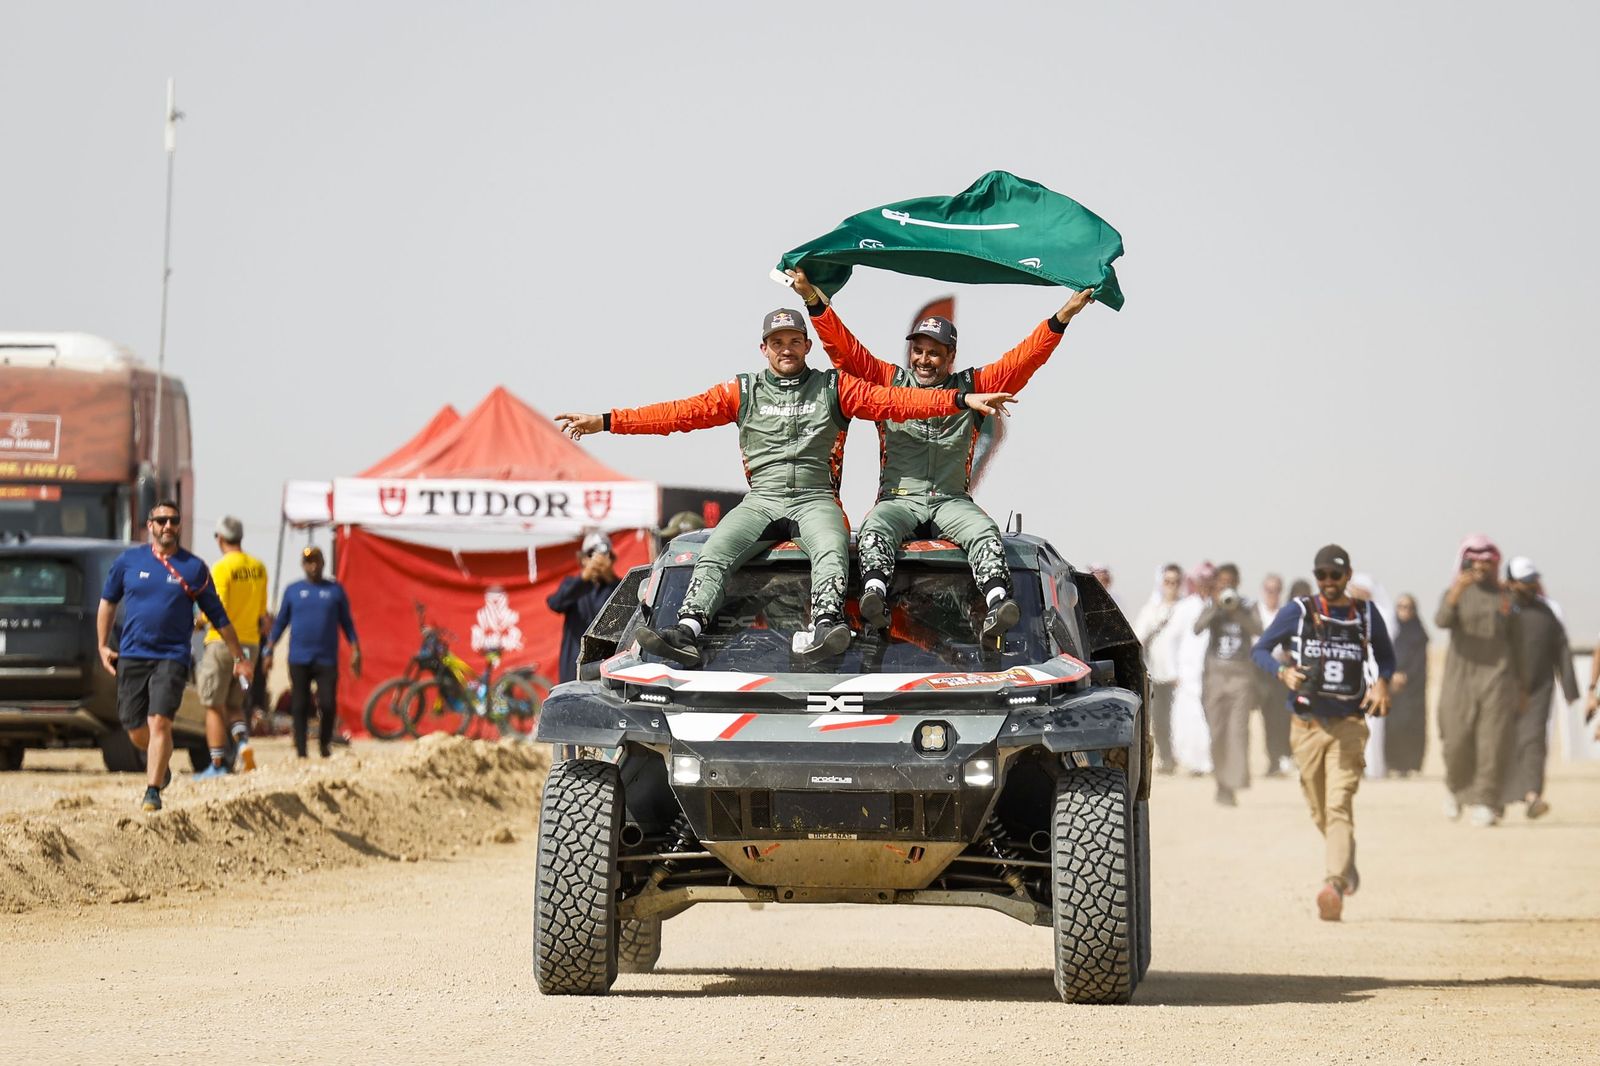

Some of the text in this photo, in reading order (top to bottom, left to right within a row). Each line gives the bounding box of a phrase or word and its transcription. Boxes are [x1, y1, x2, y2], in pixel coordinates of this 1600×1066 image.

[420, 491, 571, 518] TUDOR
[1323, 660, 1344, 683] 8
[811, 776, 852, 784] prodrive
